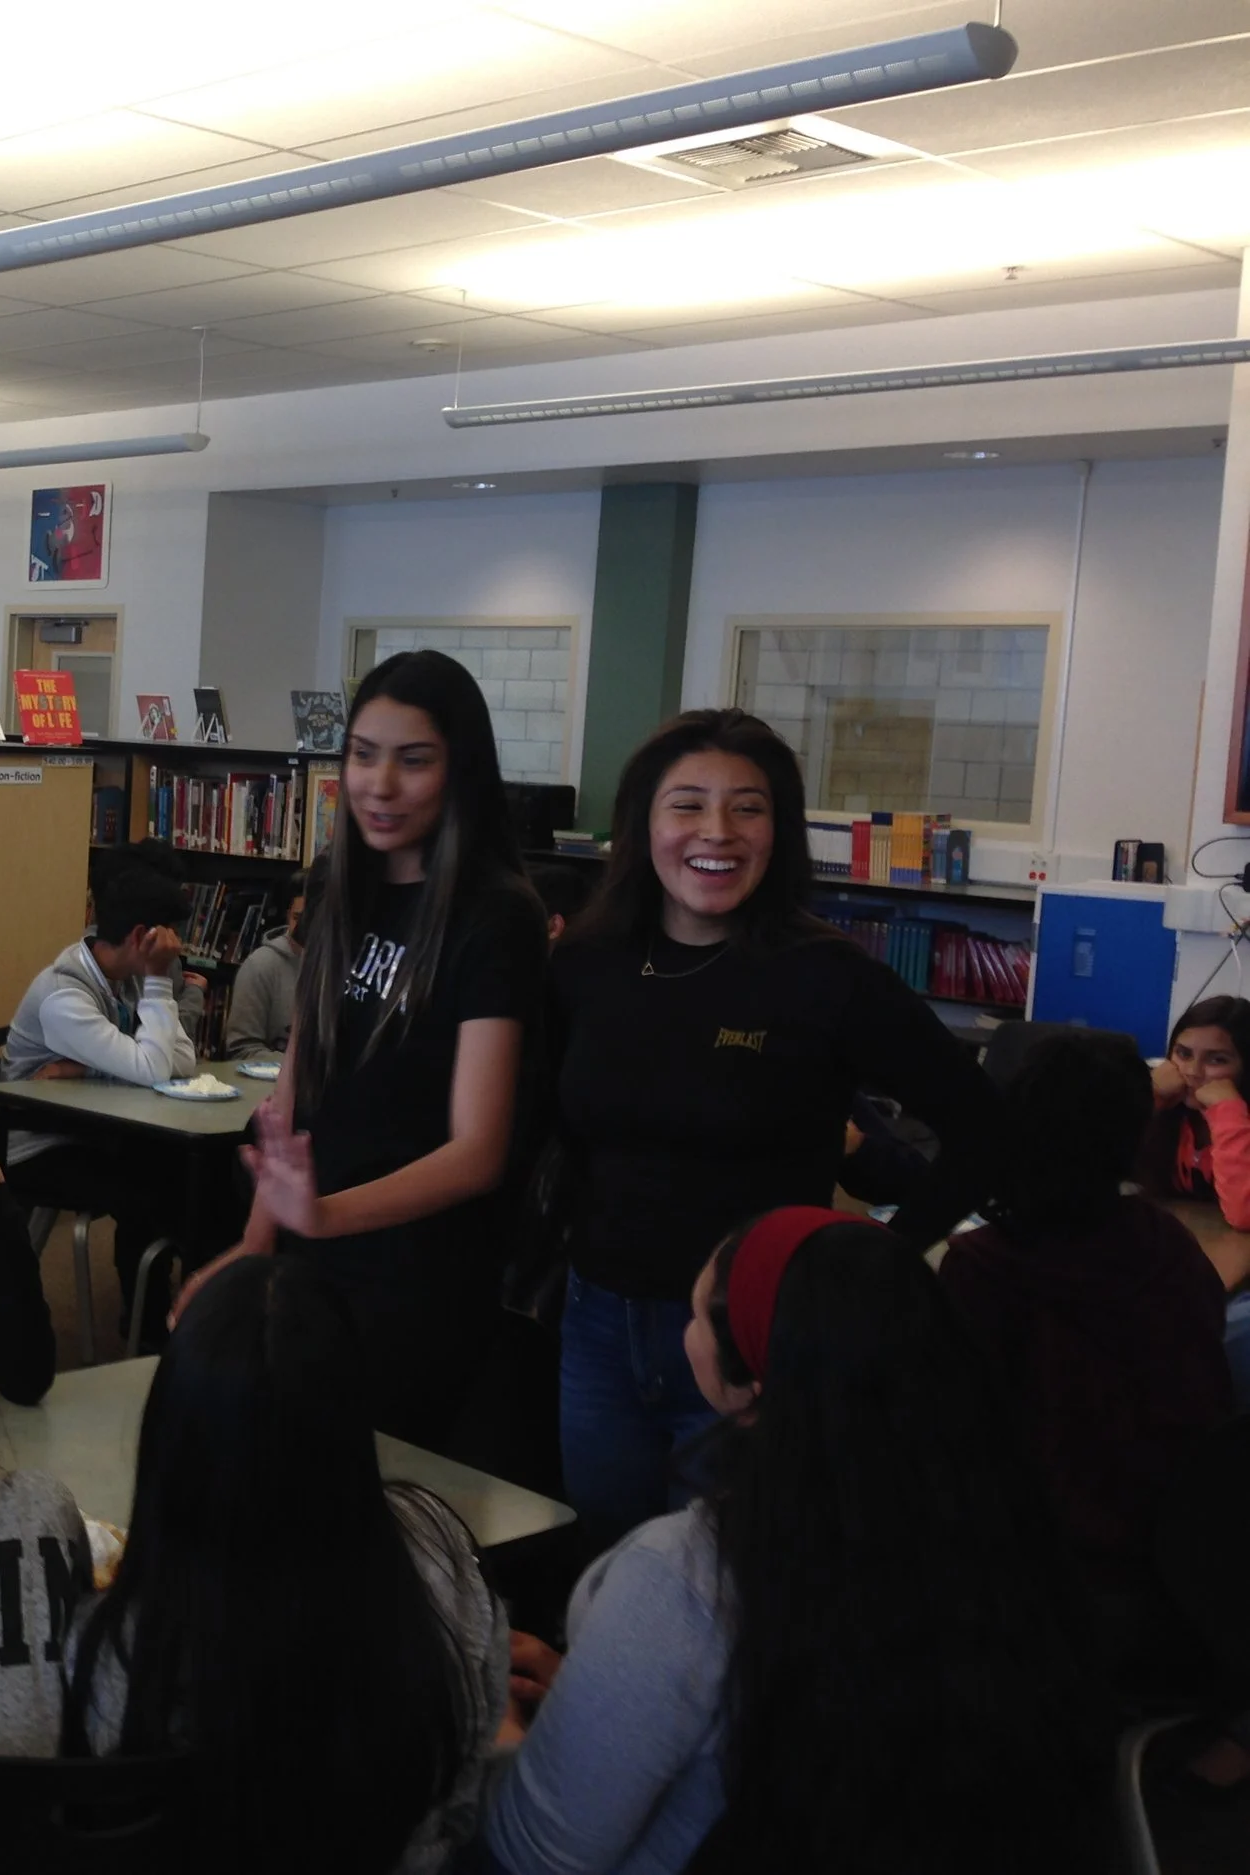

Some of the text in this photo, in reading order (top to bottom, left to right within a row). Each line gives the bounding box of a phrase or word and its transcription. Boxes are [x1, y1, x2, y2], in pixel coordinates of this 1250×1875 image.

[36, 678, 58, 693] THE
[20, 694, 77, 711] MYSTERY
[32, 712, 45, 728] OF
